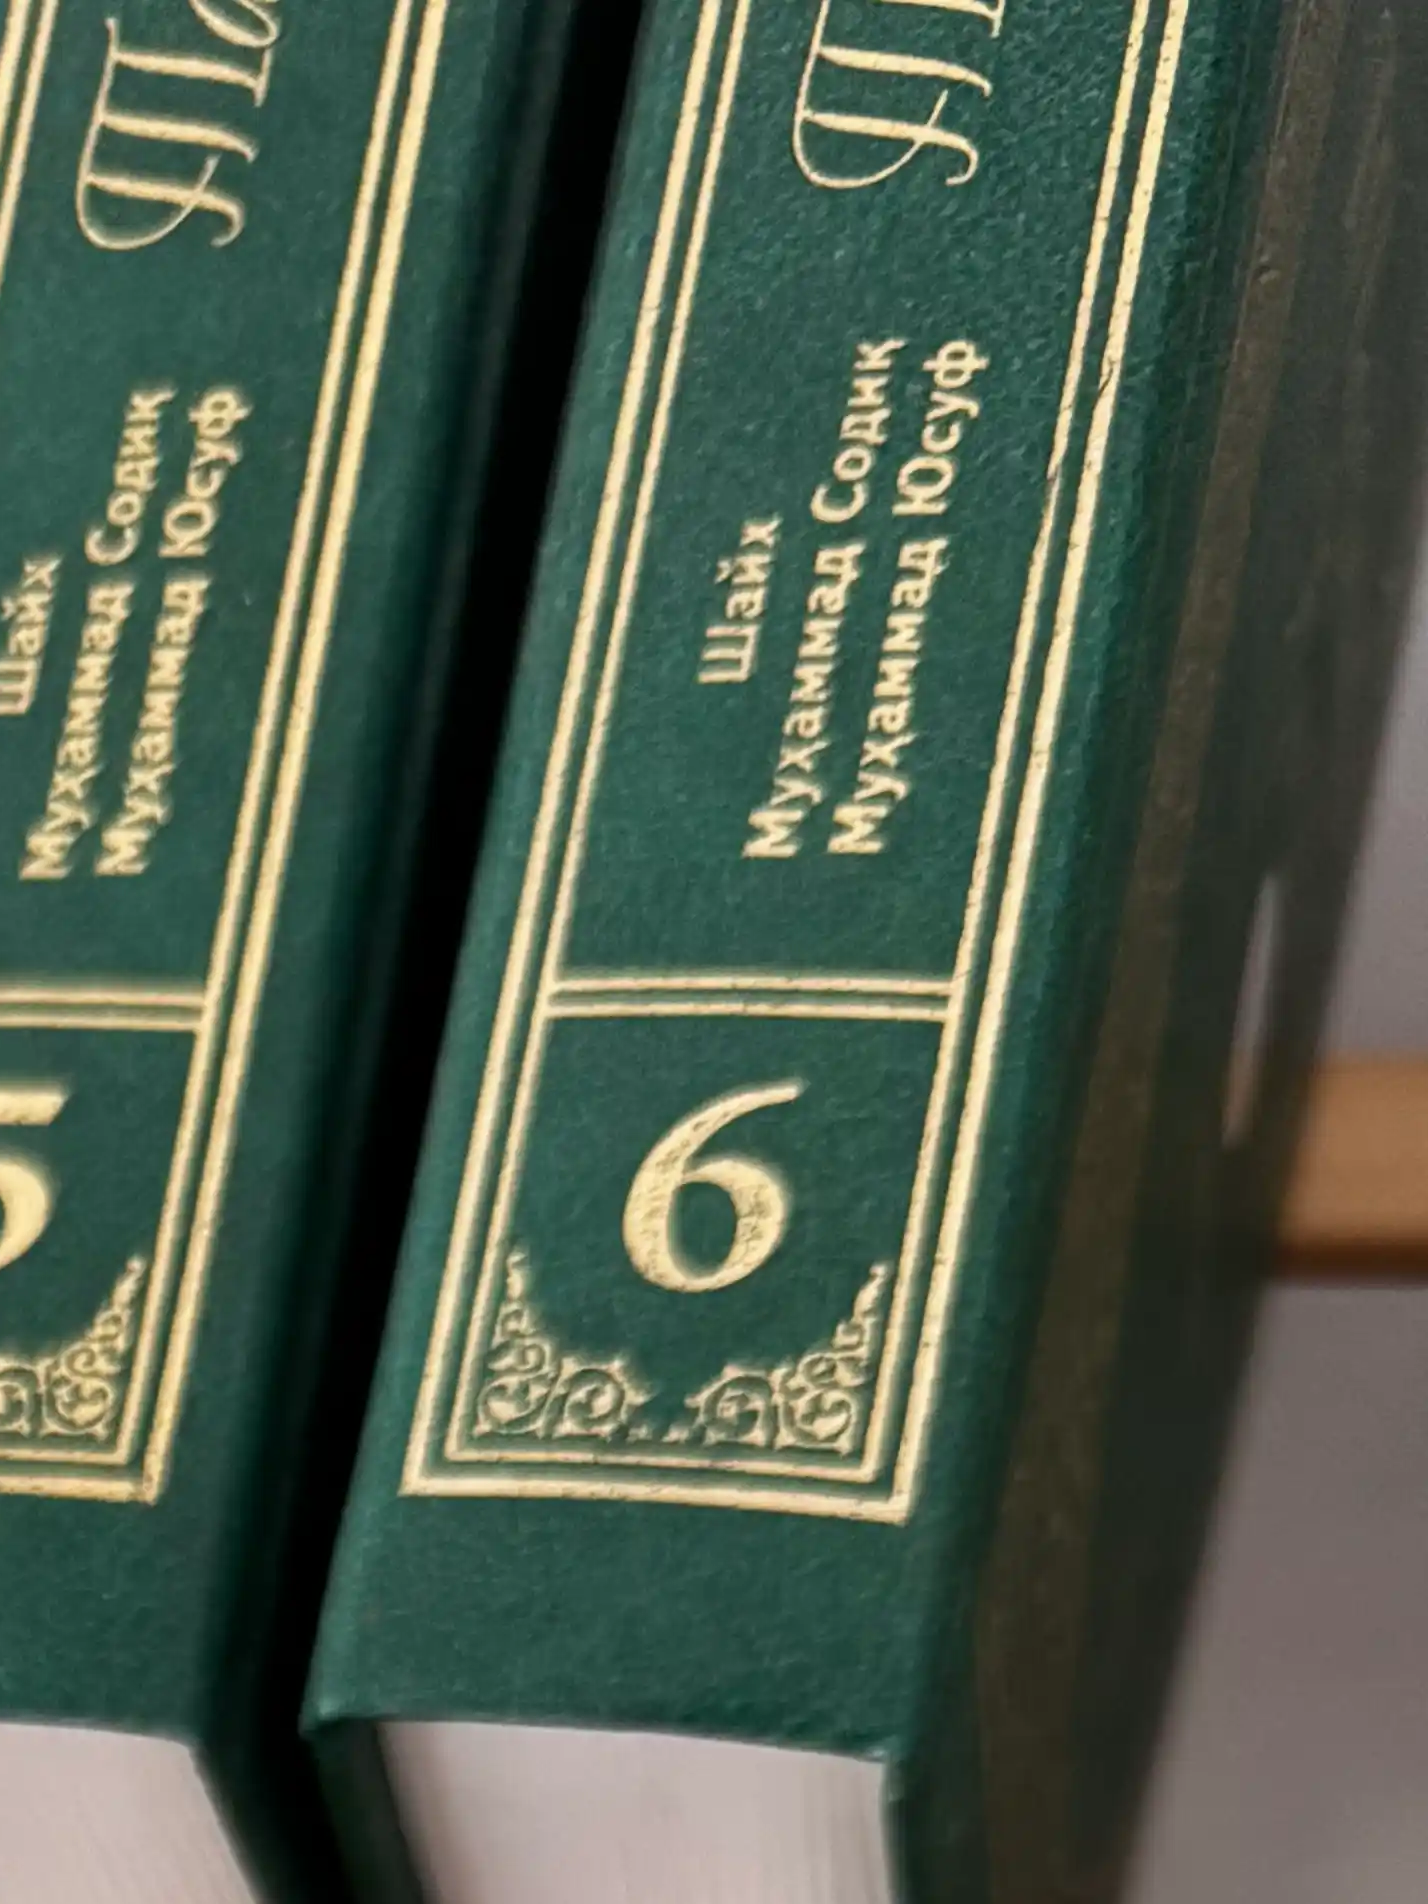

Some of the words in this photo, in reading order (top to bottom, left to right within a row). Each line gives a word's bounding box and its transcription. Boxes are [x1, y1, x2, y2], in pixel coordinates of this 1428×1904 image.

[158, 387, 252, 557] Юсуф
[892, 339, 988, 516] Юсуф
[697, 516, 780, 684] Шайх
[621, 1078, 809, 1294] 6
